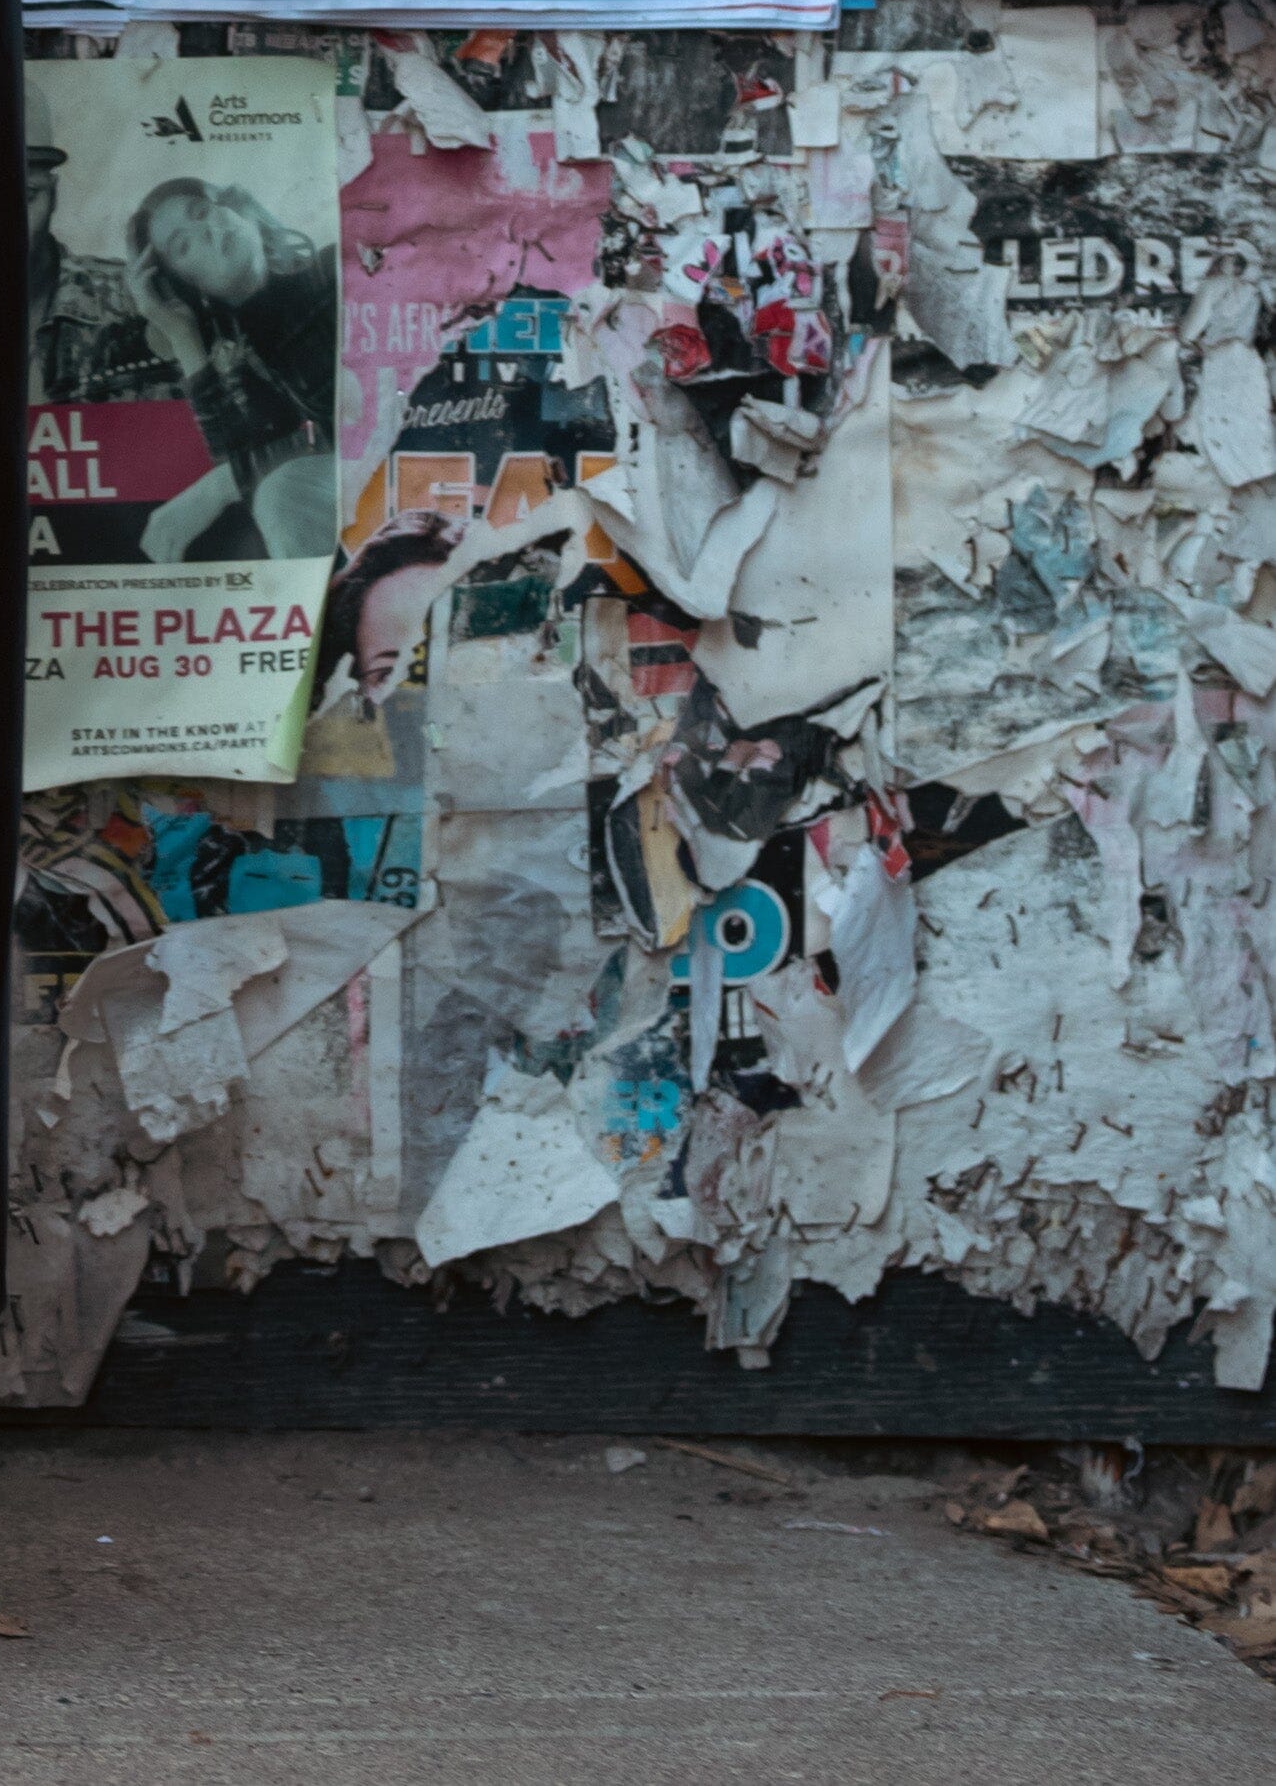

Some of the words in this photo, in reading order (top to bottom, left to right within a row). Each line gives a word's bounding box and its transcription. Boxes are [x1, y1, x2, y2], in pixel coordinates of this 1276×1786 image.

[1004, 239, 1125, 297] LED
[42, 610, 140, 647] THE
[155, 607, 312, 645] PLAZA
